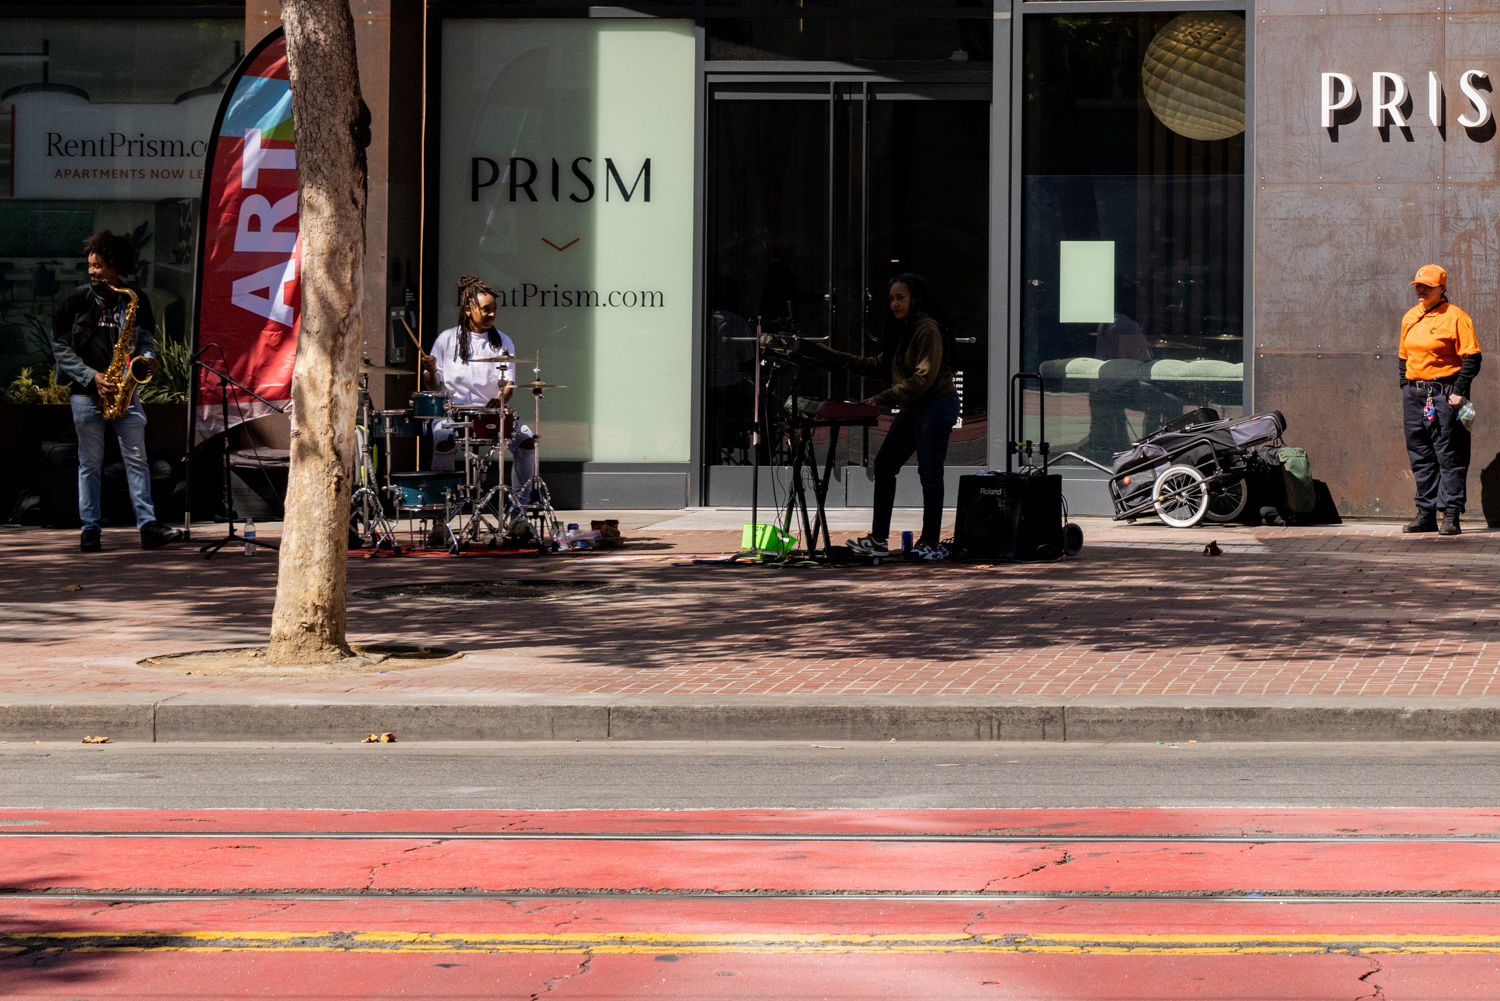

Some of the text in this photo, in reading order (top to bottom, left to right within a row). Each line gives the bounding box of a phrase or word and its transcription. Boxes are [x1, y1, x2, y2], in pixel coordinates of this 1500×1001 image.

[46, 131, 209, 158] RentPrism.c
[55, 168, 146, 179] APARTMENTS
[150, 168, 185, 179] NOW
[470, 156, 652, 203] PRISM
[231, 128, 299, 328] ART
[456, 282, 666, 308] ntPrism.com
[980, 487, 1003, 496] Roland
